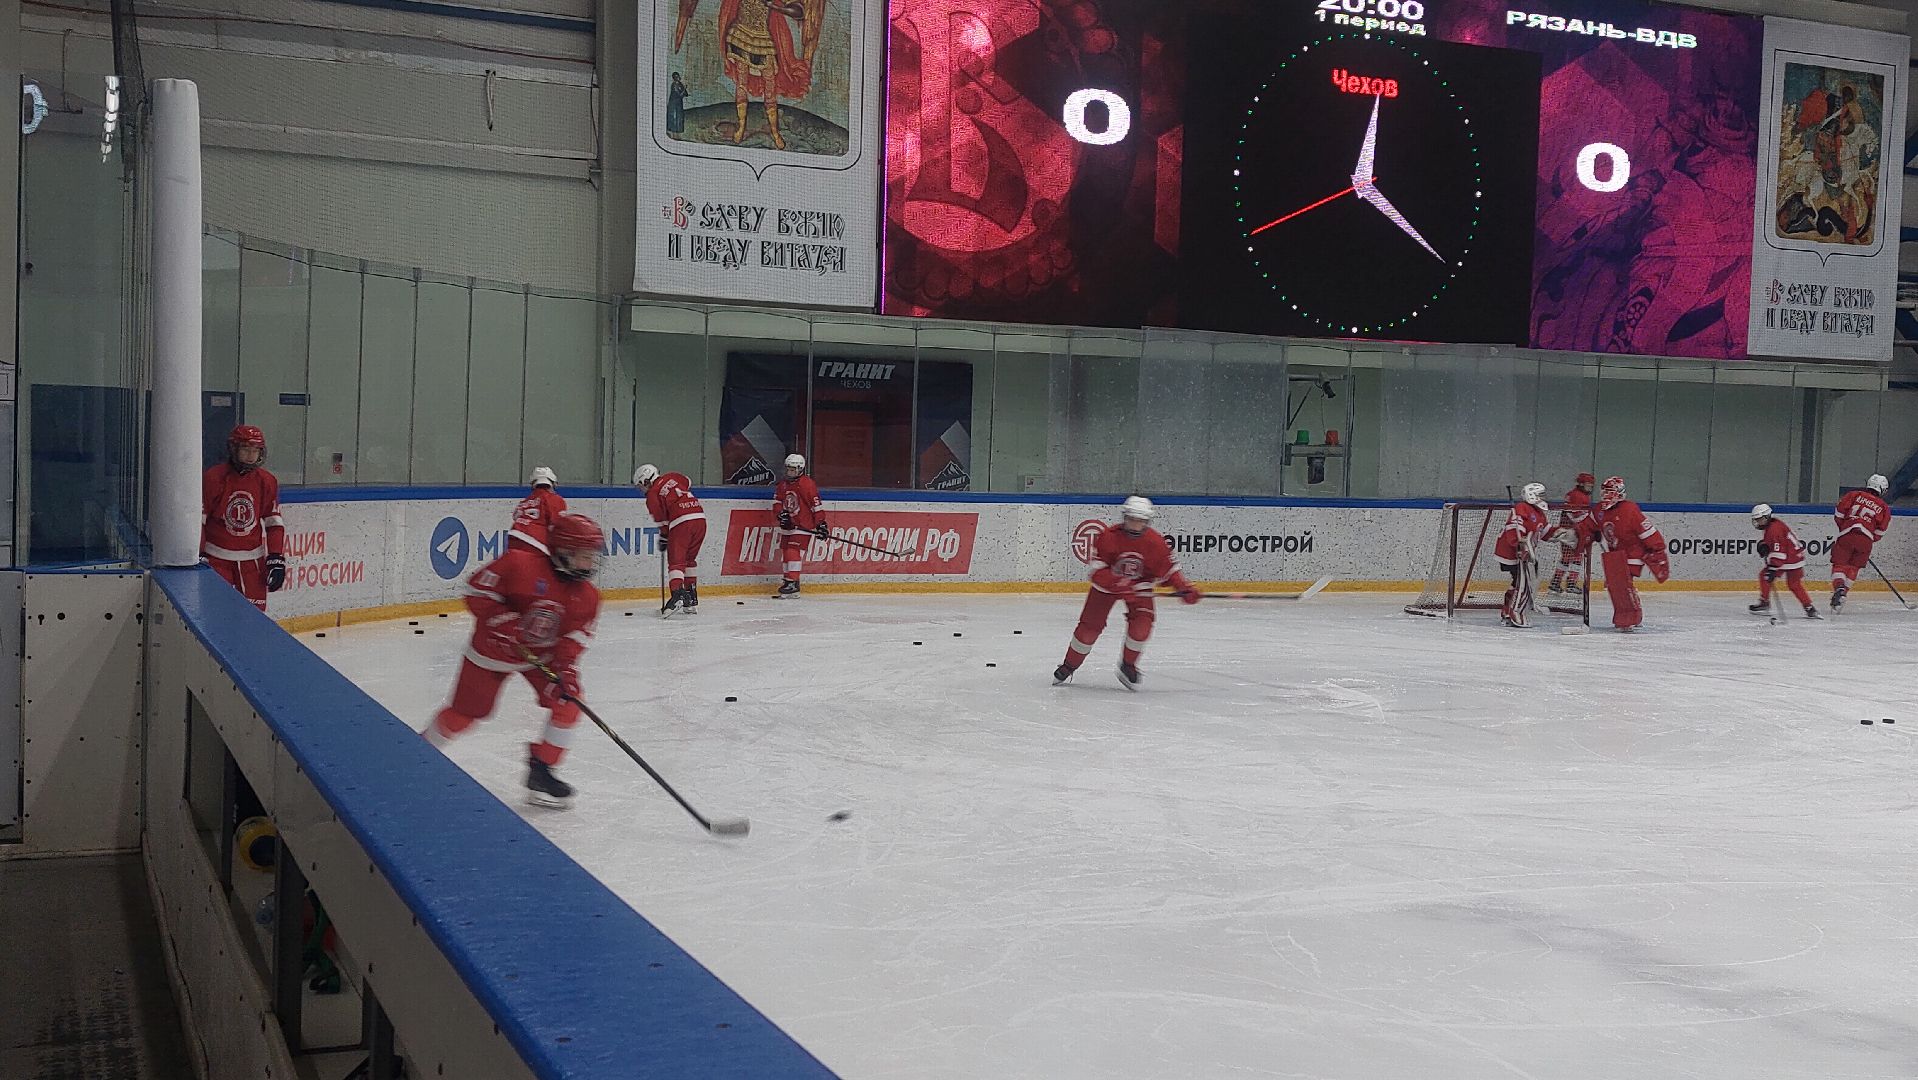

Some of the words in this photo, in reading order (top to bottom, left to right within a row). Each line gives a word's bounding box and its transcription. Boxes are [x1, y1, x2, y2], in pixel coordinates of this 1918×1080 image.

[1315, 9, 1326, 21] 1
[1334, 13, 1426, 36] период
[1506, 10, 1698, 48] РЯЗАНЬ-ВДВ
[1332, 68, 1398, 98] Чехов
[1063, 88, 1131, 145] 0
[1576, 142, 1630, 193] 0
[818, 361, 896, 380] ГРАНИТ
[841, 380, 872, 389] ЧЕХОВ
[738, 472, 769, 486] ГРАНИТ
[938, 476, 966, 490] ГРАНИТ
[282, 532, 325, 559] АЦИЯ
[738, 527, 961, 562] ИГРВРОССИИ.РФ
[298, 561, 364, 588] РОССИИ
